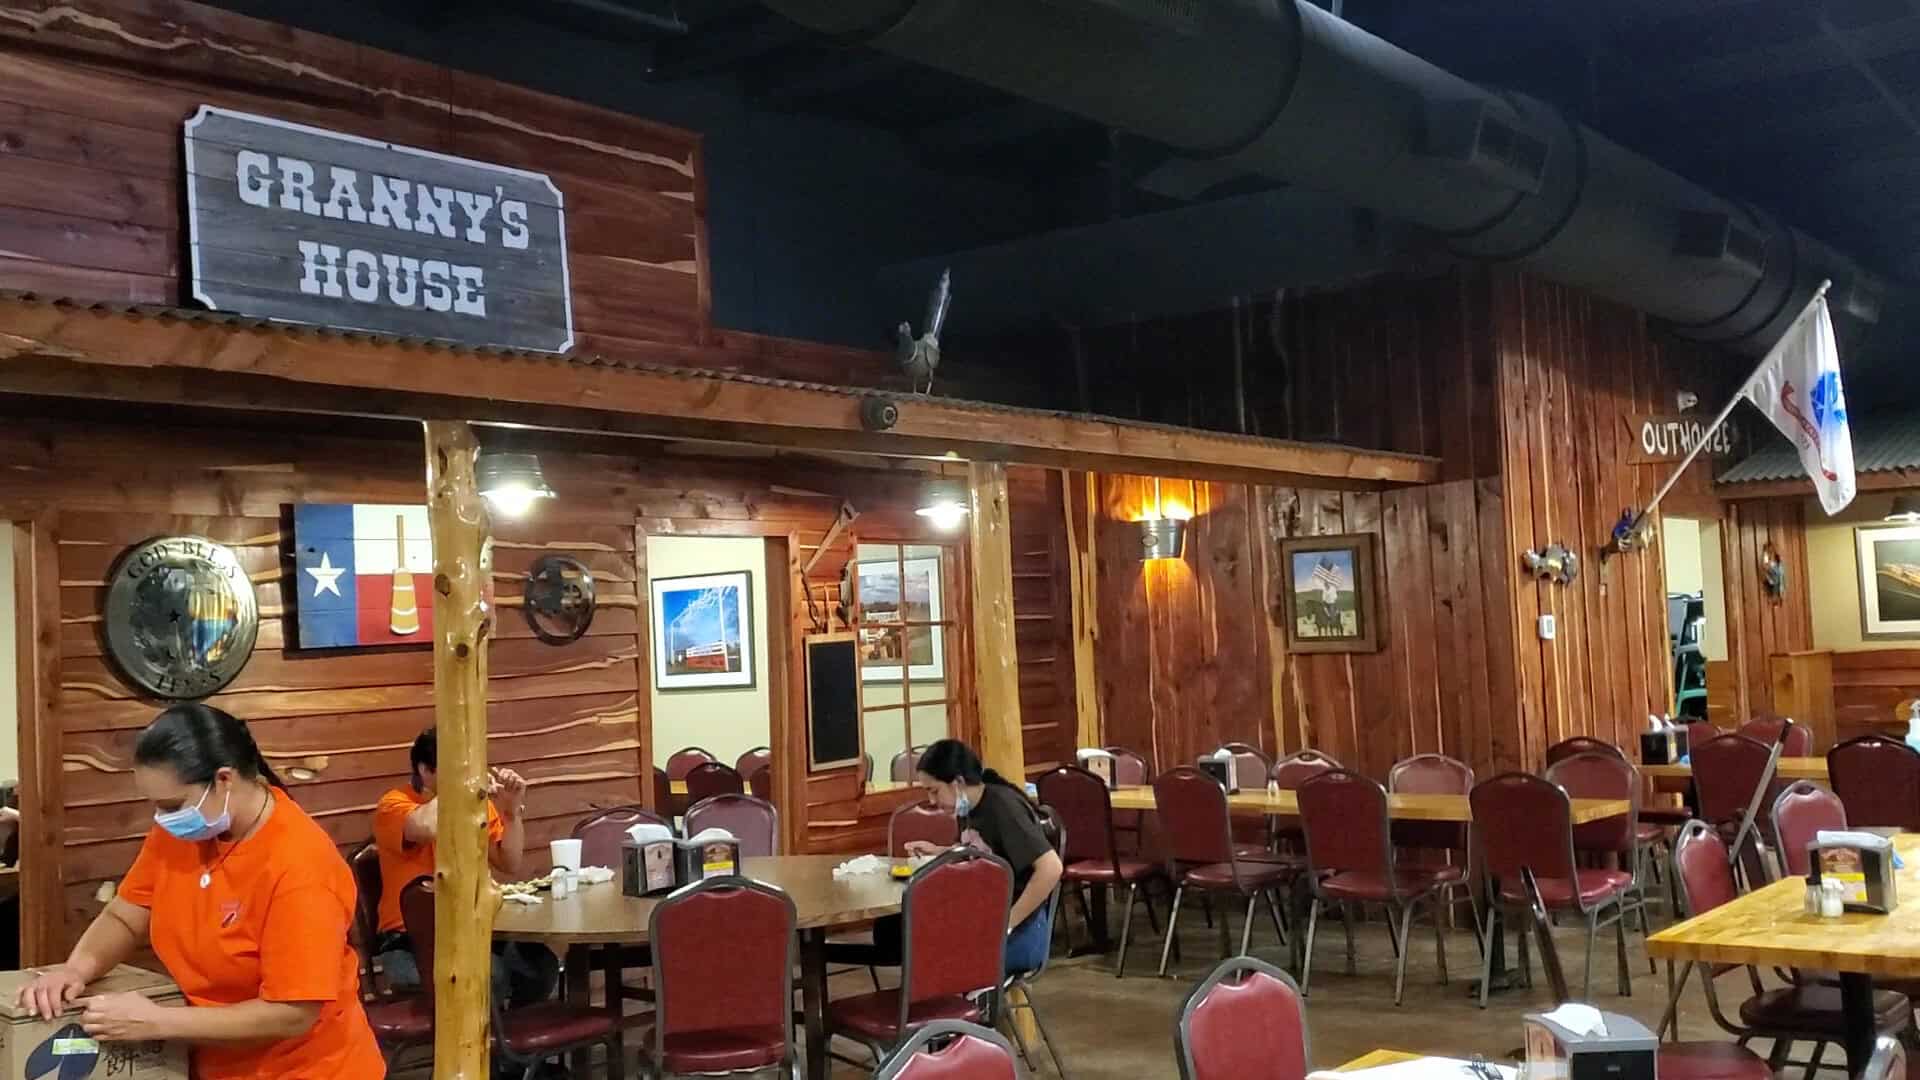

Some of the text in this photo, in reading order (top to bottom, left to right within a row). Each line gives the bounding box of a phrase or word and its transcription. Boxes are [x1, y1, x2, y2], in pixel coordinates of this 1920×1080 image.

[237, 150, 528, 248] GRANNY'S
[298, 241, 486, 318] HOUSE
[1642, 421, 1731, 455] OUTHOUSE
[127, 542, 238, 579] GOD BLES
